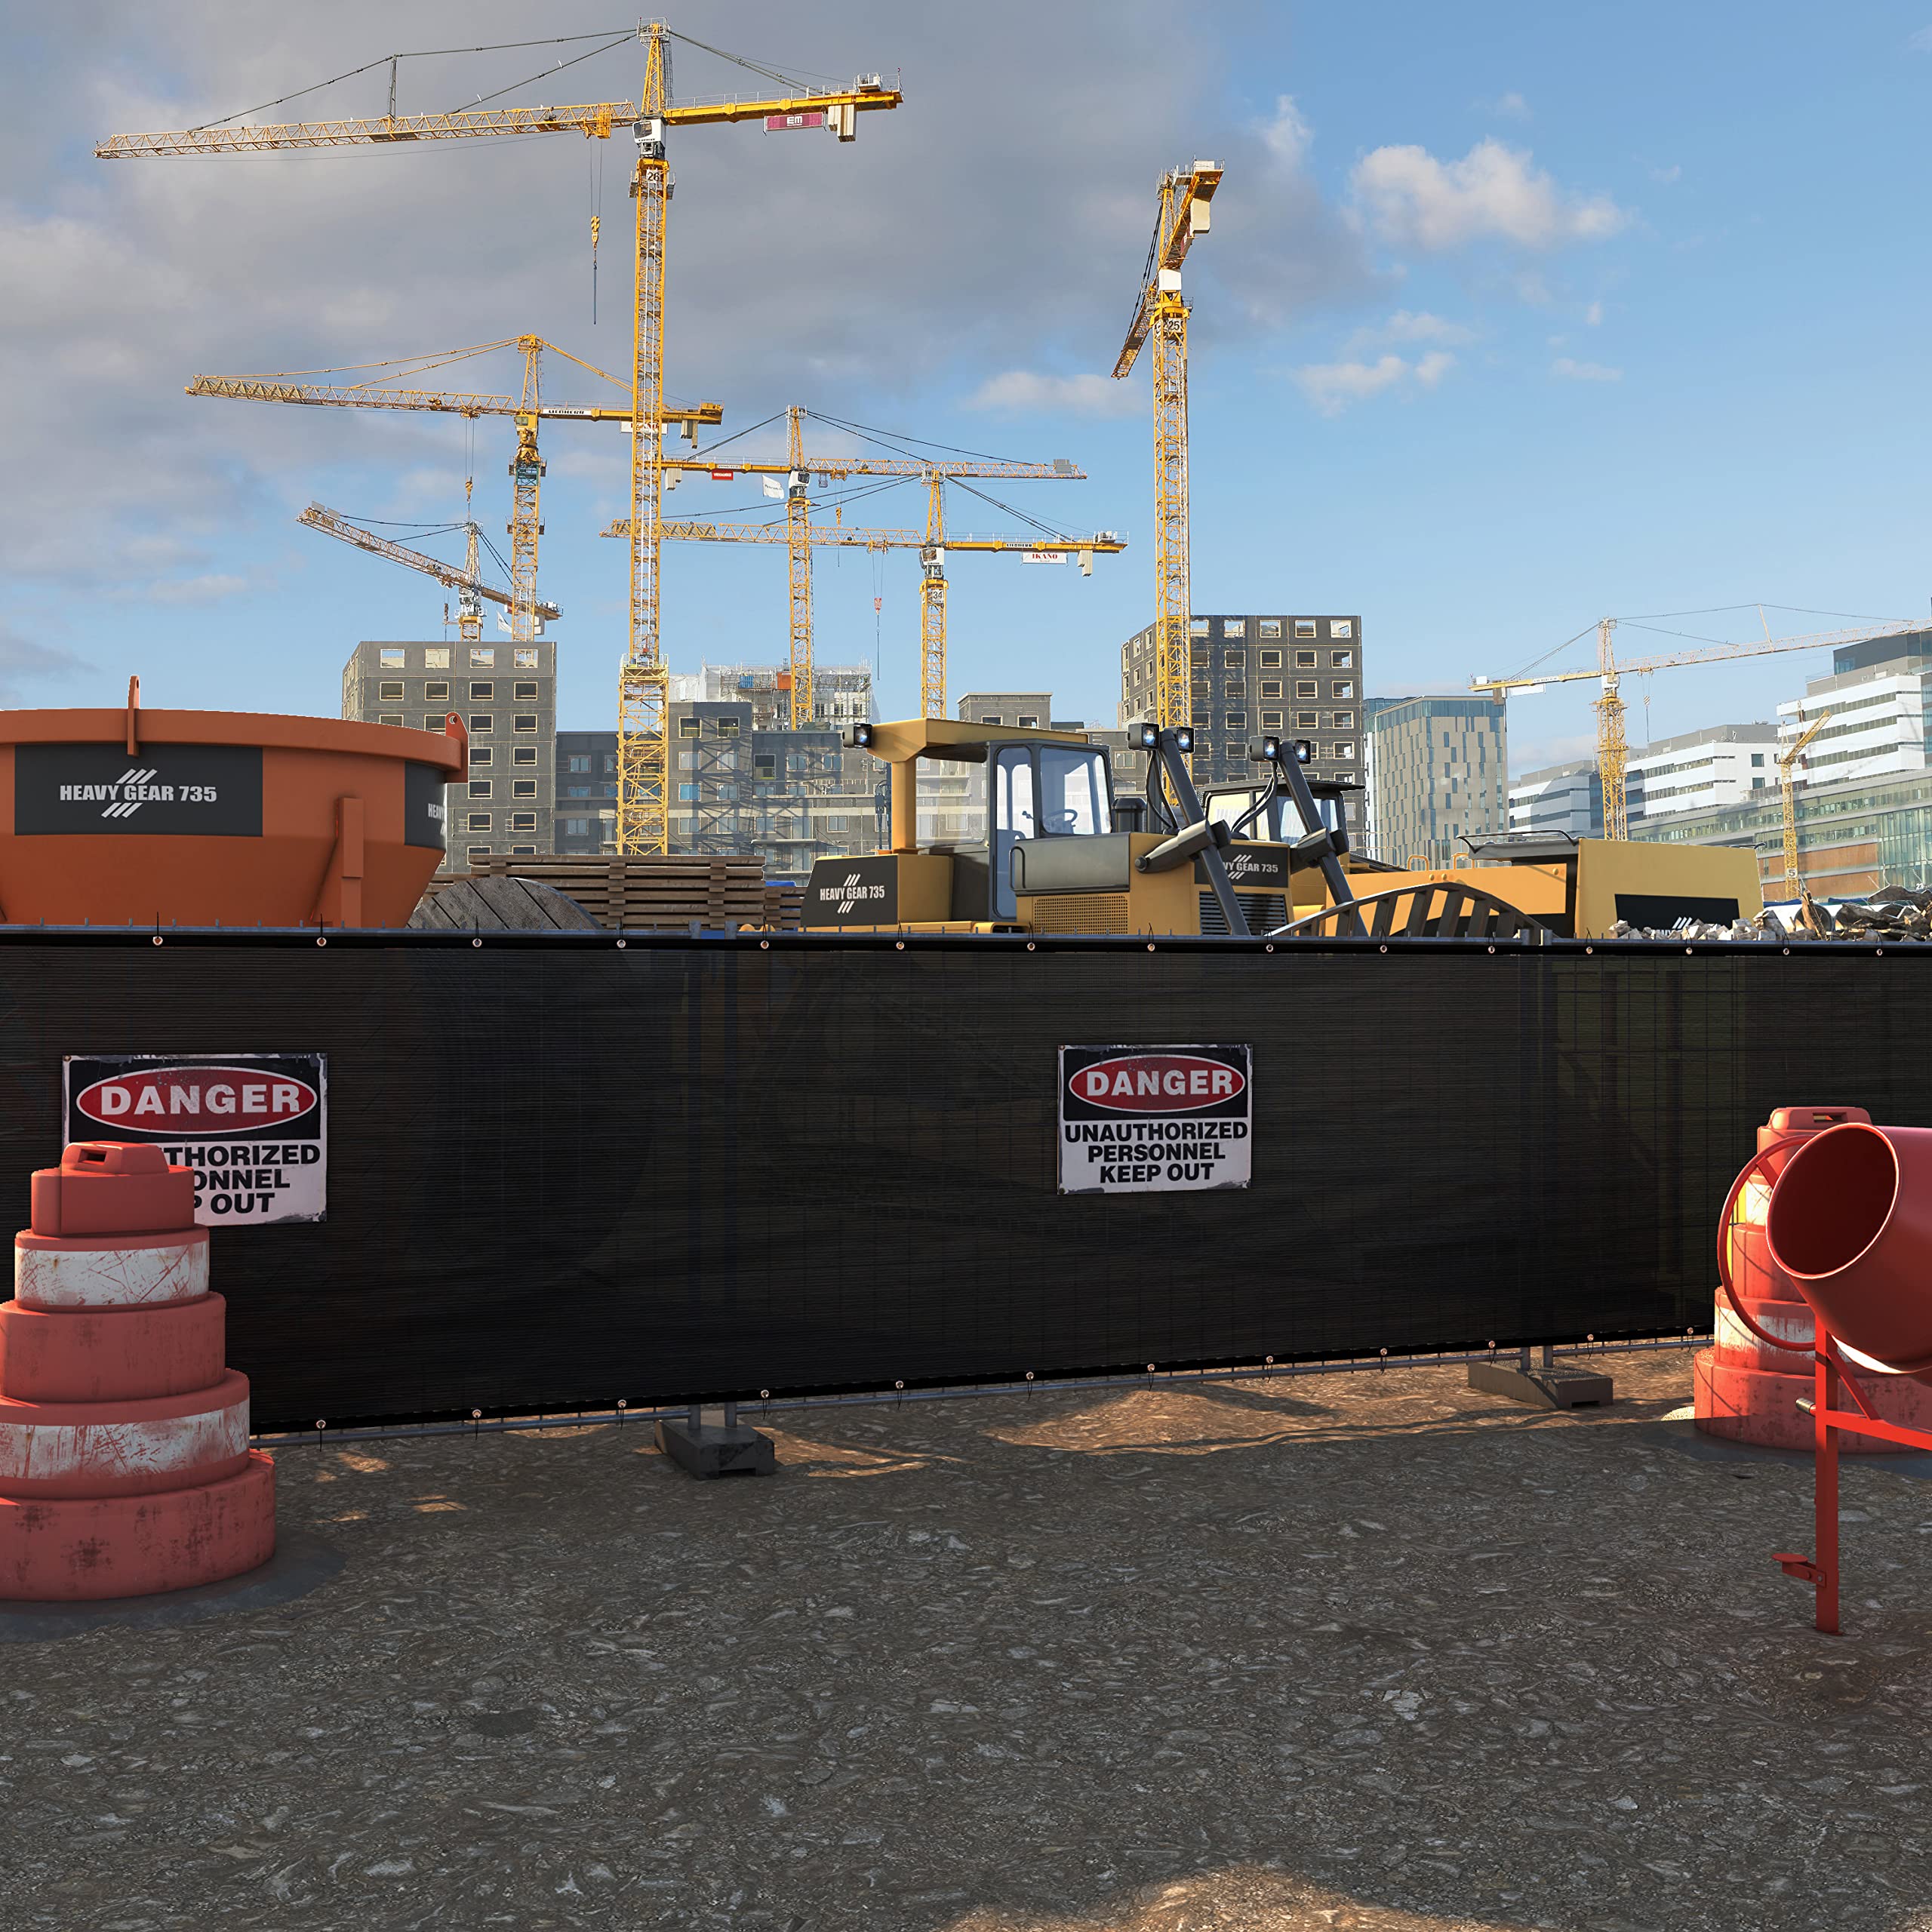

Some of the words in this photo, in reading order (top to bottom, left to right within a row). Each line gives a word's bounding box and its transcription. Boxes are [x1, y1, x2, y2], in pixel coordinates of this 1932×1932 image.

[786, 115, 803, 124] EM
[648, 172, 660, 181] 26
[1168, 321, 1180, 331] 25
[934, 591, 943, 599] 34
[60, 785, 119, 801] HEAVY
[124, 785, 174, 801] GEAR
[179, 786, 217, 801] 735
[1236, 863, 1260, 872] GEAR
[1261, 863, 1278, 873] 735
[820, 888, 845, 900] HEAVY
[846, 886, 868, 900] GEAR
[869, 885, 885, 898] 735
[1087, 1069, 1234, 1097] DANGER
[101, 1084, 300, 1115] DANGER
[1065, 1121, 1247, 1143] UNAUTHORIZED
[160, 1145, 321, 1167] THORIZED
[1088, 1143, 1226, 1162] PERSONNEL
[194, 1169, 291, 1191] ONNEL
[1100, 1164, 1161, 1183] KEEP
[1168, 1163, 1214, 1181] OUT
[211, 1192, 275, 1214] OUT
